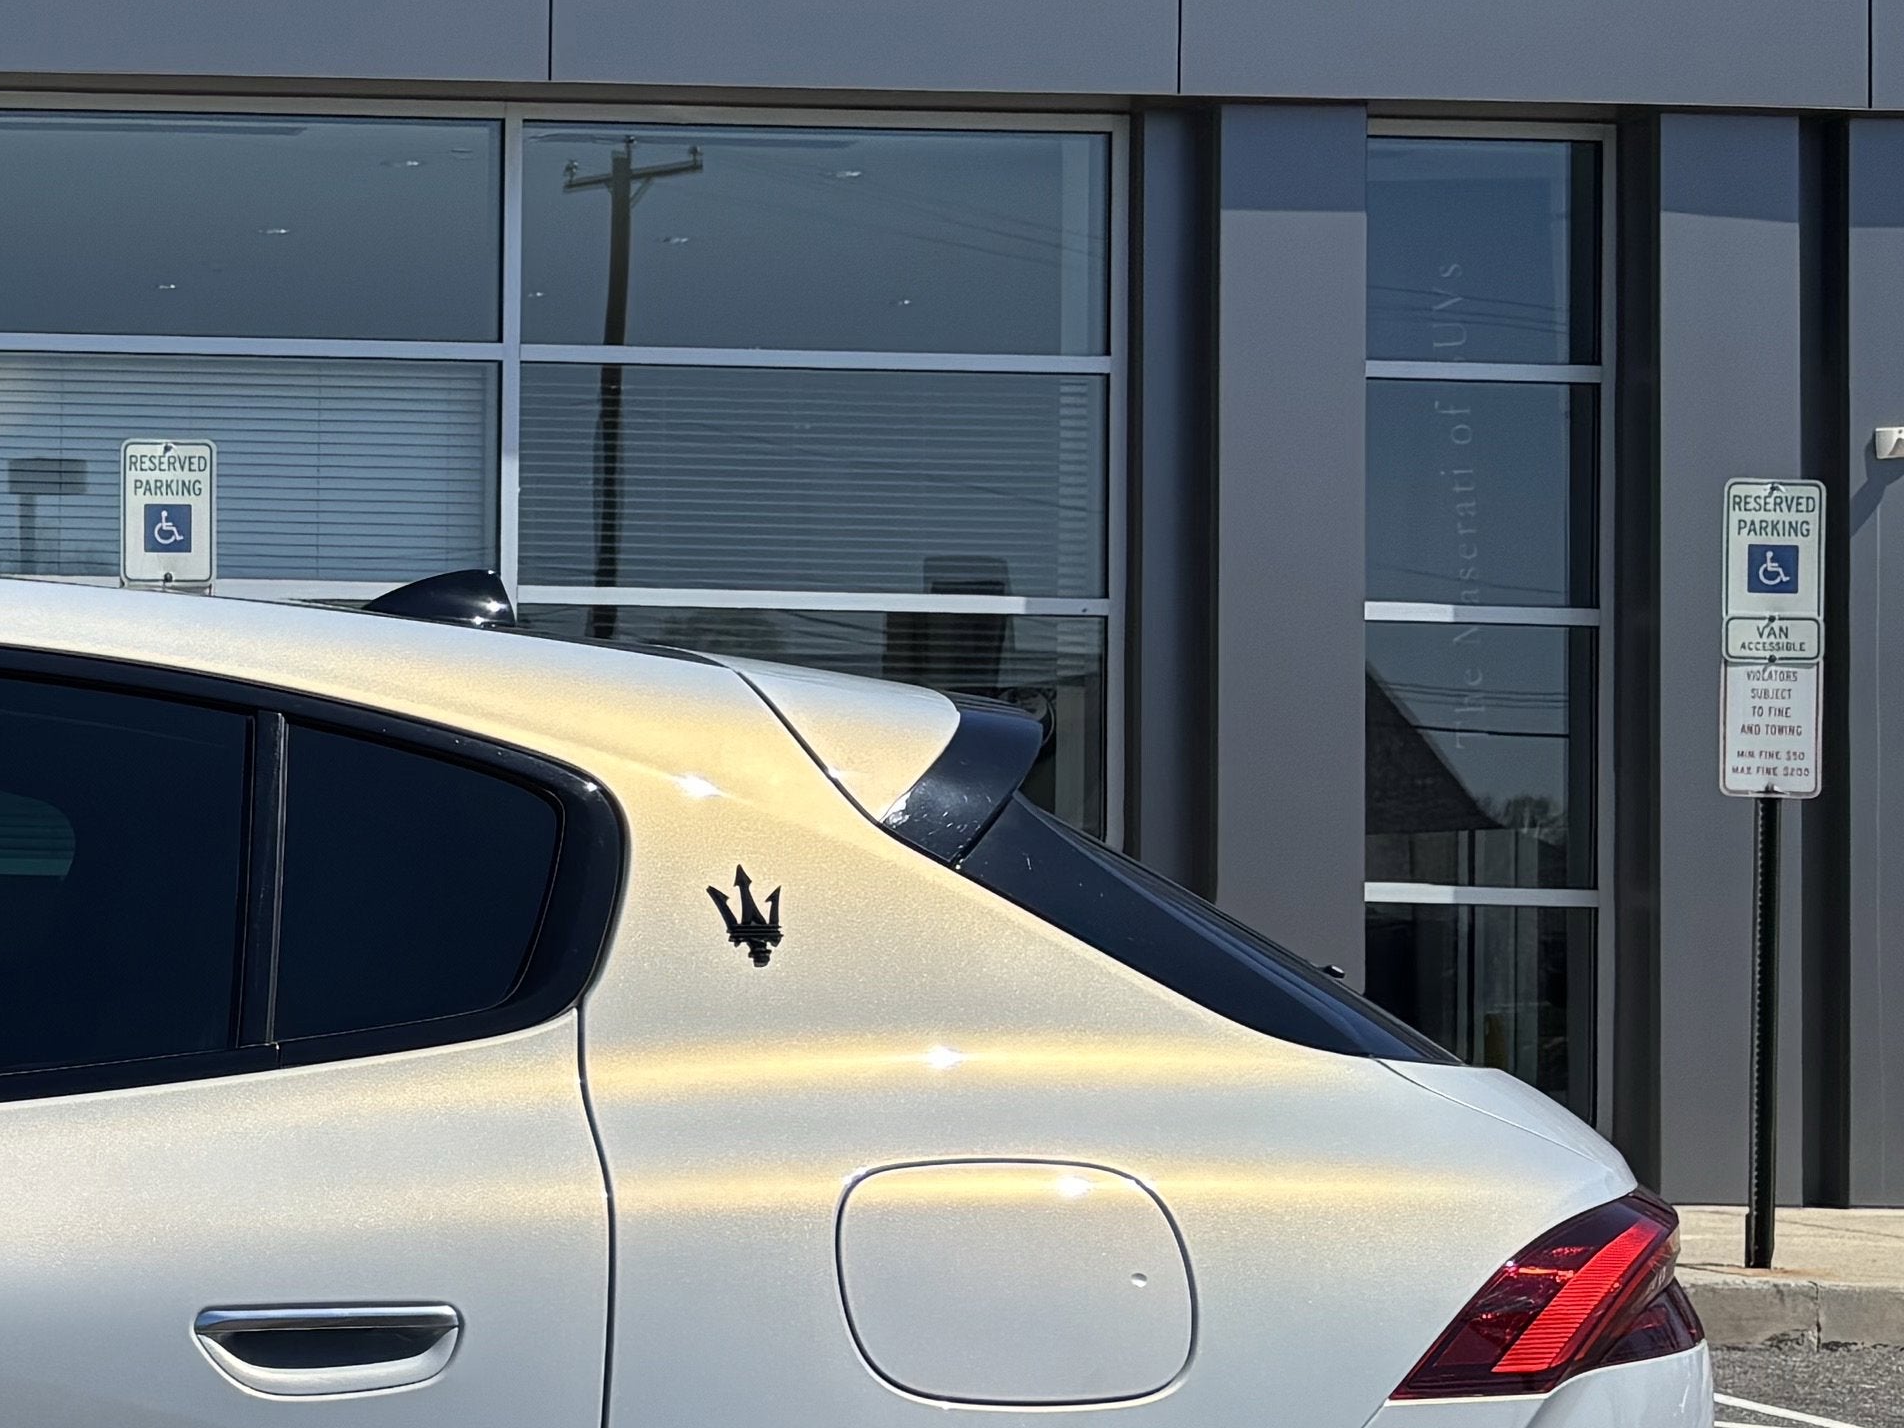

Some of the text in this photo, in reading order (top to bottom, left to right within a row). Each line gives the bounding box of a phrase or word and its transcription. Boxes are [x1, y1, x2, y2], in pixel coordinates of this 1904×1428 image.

[128, 455, 207, 472] RESERVED
[134, 479, 202, 497] PARKING
[1733, 495, 1815, 513] RESERVED
[1738, 519, 1810, 537] PARKING
[1757, 626, 1789, 639] VAN
[1740, 642, 1806, 652] ACCESSIBLE
[1747, 670, 1798, 682] VIOLATORS
[1751, 688, 1792, 700] SUBJECT
[1752, 706, 1791, 718] TO FINE
[1740, 724, 1802, 736] AND TOWING
